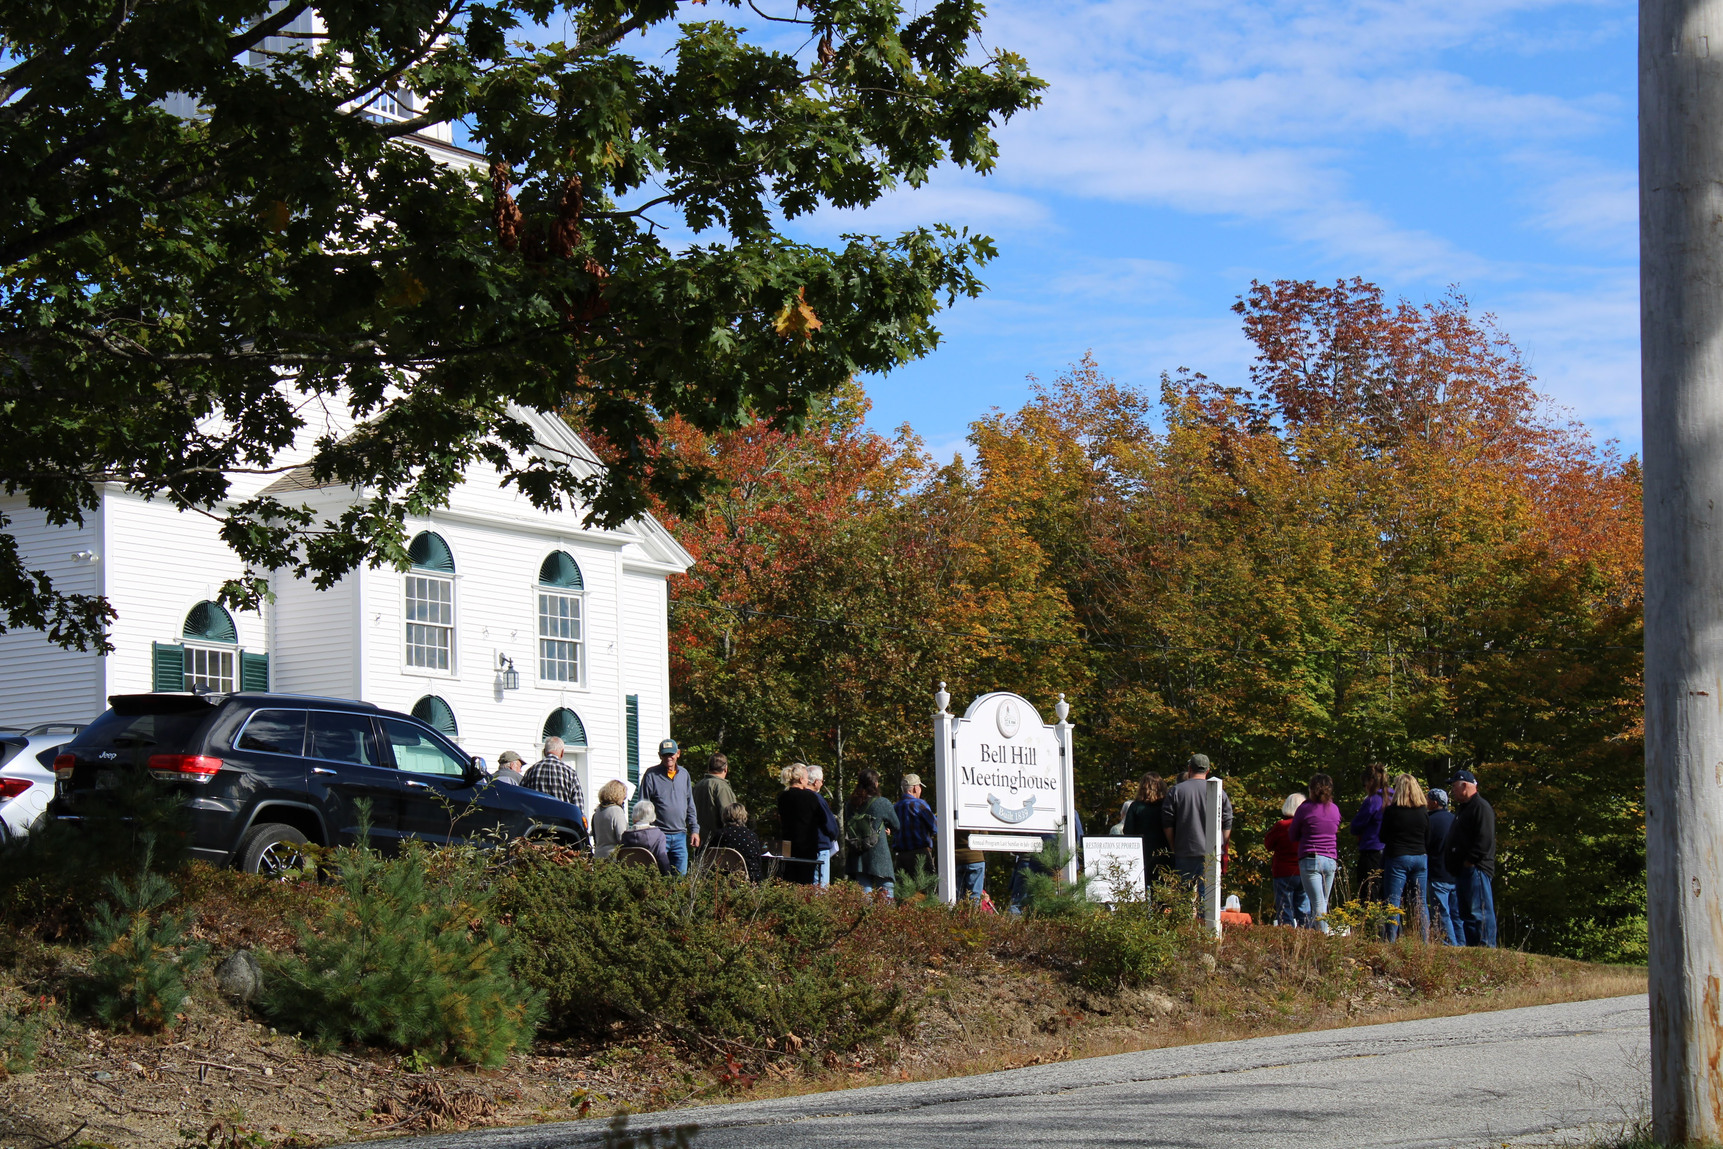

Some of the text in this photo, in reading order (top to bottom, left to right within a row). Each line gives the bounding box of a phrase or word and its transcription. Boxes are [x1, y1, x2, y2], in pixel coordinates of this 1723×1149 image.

[98, 750, 117, 761] Jeep
[980, 743, 1037, 766] Bell Hill
[961, 766, 1057, 795] Meetinghouse
[998, 807, 1029, 821] Built 1839
[985, 839, 1000, 847] Program
[1115, 842, 1141, 850] SUPPORTED
